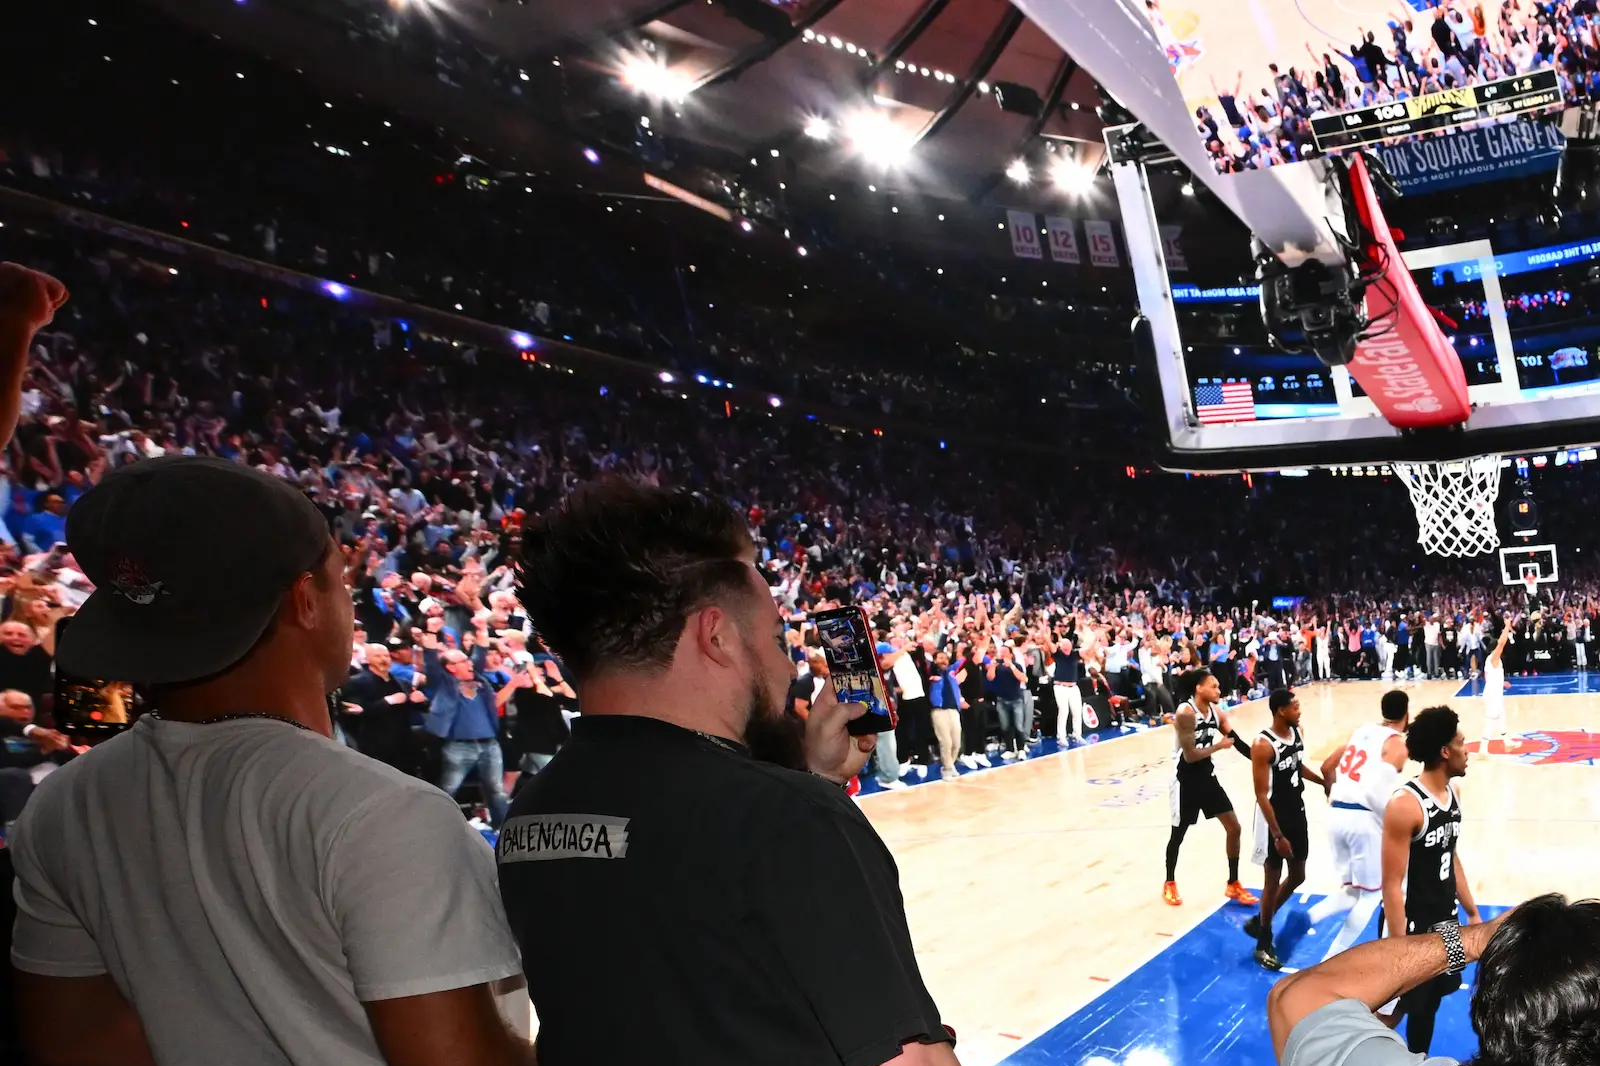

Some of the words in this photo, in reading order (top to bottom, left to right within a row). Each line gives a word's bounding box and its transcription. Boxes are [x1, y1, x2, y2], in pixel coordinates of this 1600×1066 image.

[1412, 132, 1485, 172] SQUARE
[1485, 120, 1561, 159] GARDEN
[1396, 175, 1428, 188] ORLD'S
[1431, 171, 1455, 182] MOST
[1458, 164, 1495, 177] FAMOUS
[1498, 157, 1529, 169] ARENA
[1014, 224, 1034, 244] 10
[1052, 230, 1073, 248] 12
[1091, 234, 1111, 252] 15
[1290, 770, 1299, 787] 4
[1340, 744, 1367, 783] 32
[503, 822, 612, 857] BALENCIAGA
[1439, 851, 1451, 881] 2
